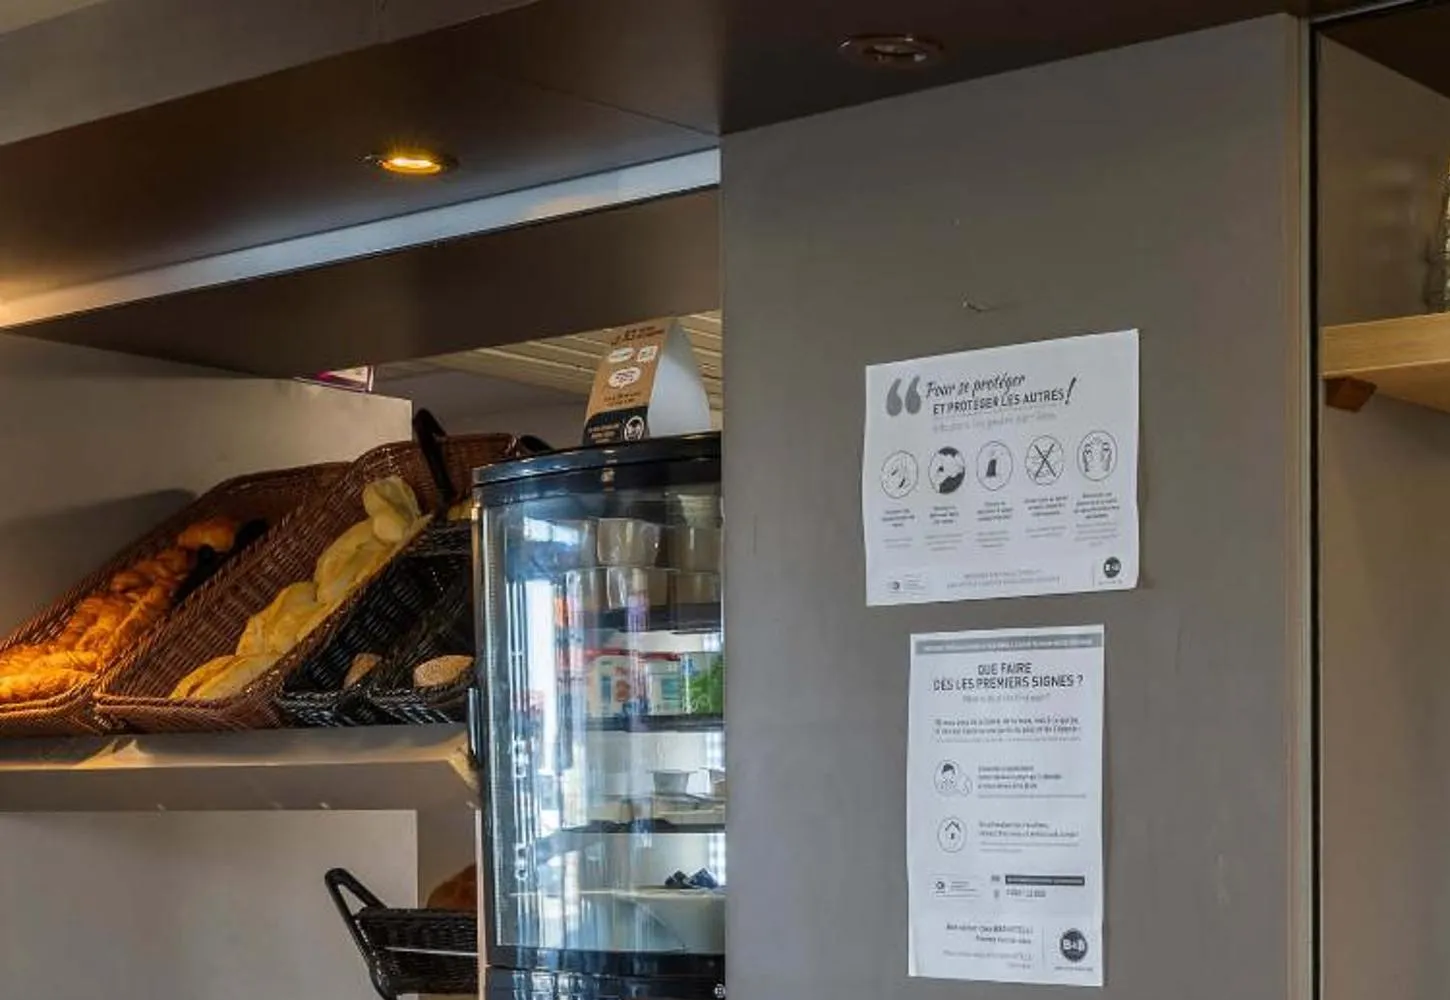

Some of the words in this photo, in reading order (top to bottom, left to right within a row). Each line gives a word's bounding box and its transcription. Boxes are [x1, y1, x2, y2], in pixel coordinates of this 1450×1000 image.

[933, 403, 945, 416] ET
[1001, 393, 1020, 406] LES
[978, 663, 997, 676] QUE
[1001, 662, 1033, 675] FAIRE
[956, 677, 975, 690] LES
[976, 676, 1029, 690] PREMIERS
[1032, 674, 1074, 688] SIGNES
